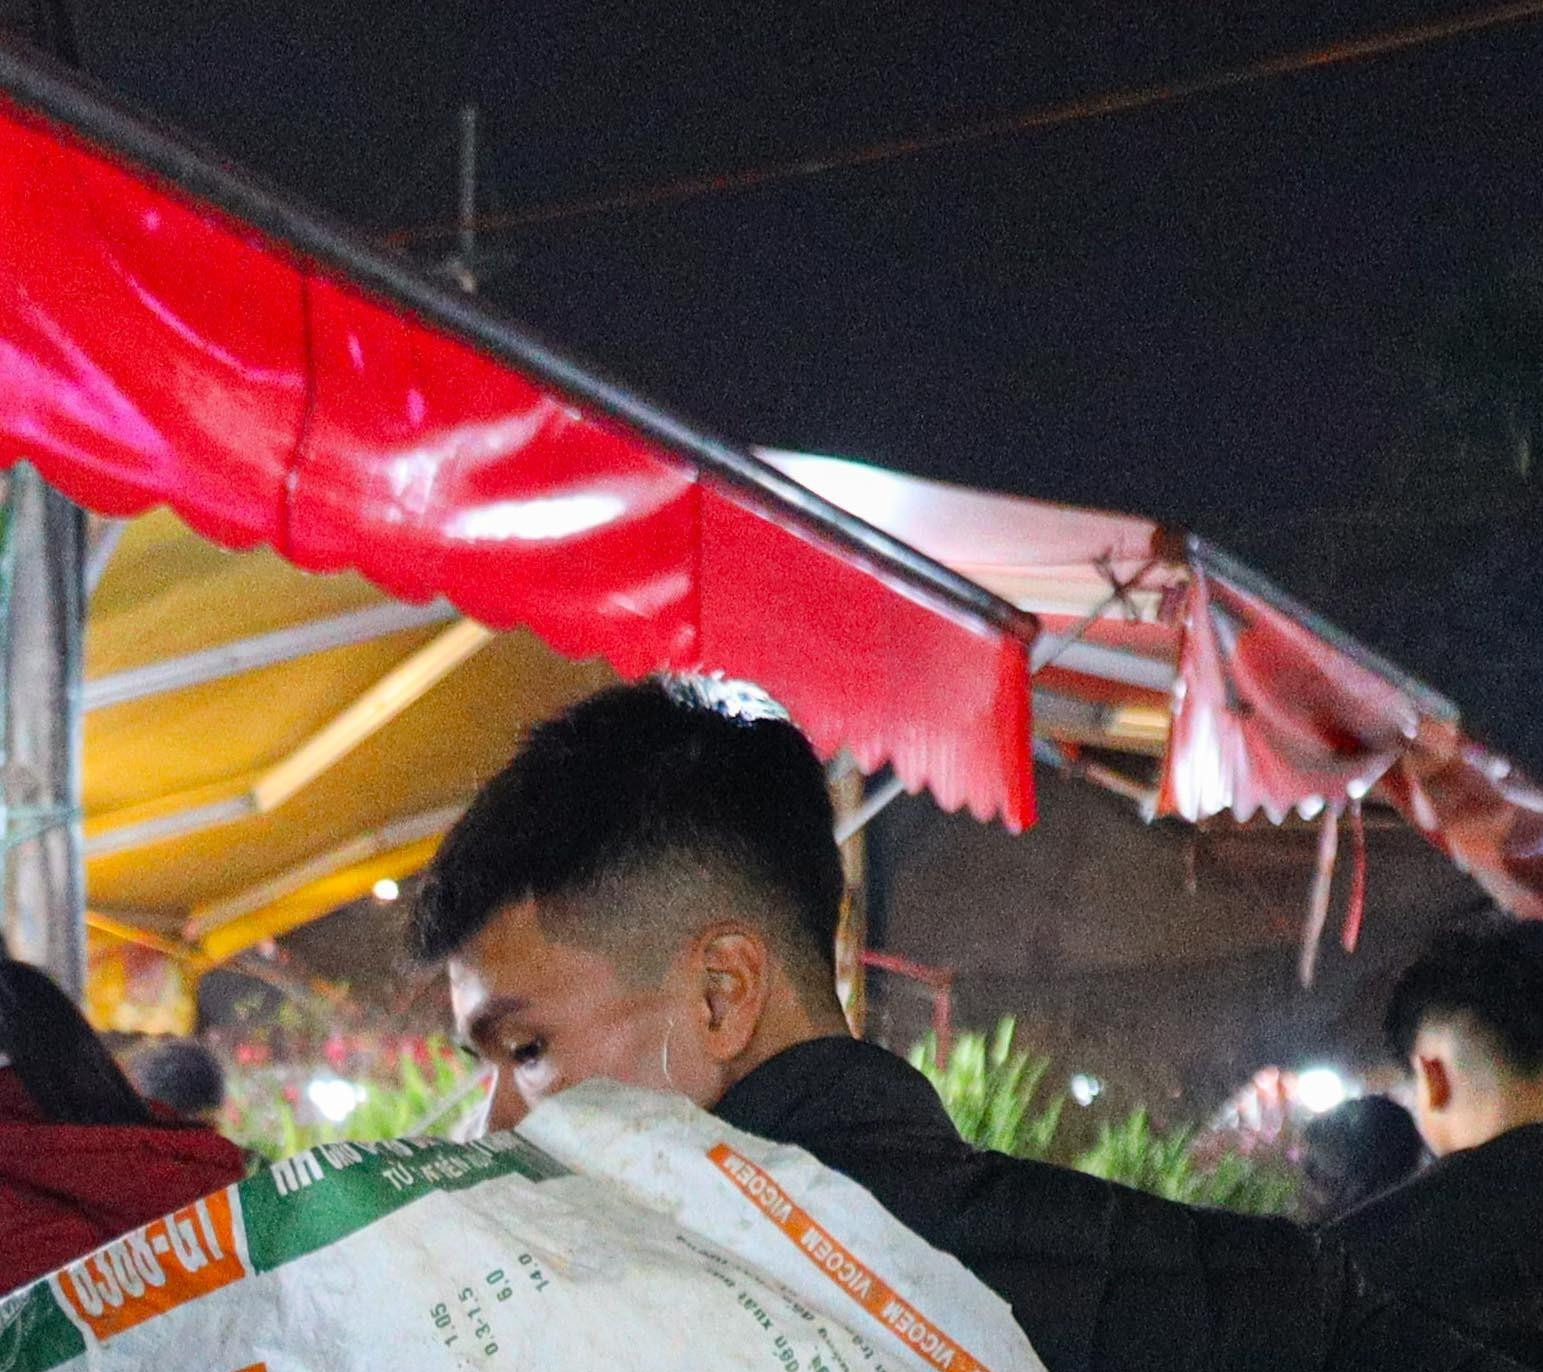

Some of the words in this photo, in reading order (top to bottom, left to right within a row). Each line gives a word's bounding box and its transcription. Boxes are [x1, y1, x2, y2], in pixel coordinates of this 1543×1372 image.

[719, 1150, 796, 1225] VICOEM
[483, 1266, 516, 1304] 6.0
[797, 1226, 875, 1300] VICOEM
[427, 1300, 462, 1347] 1.05
[454, 1285, 502, 1357] 0.3-1.5
[878, 1297, 958, 1369] VICOEM
